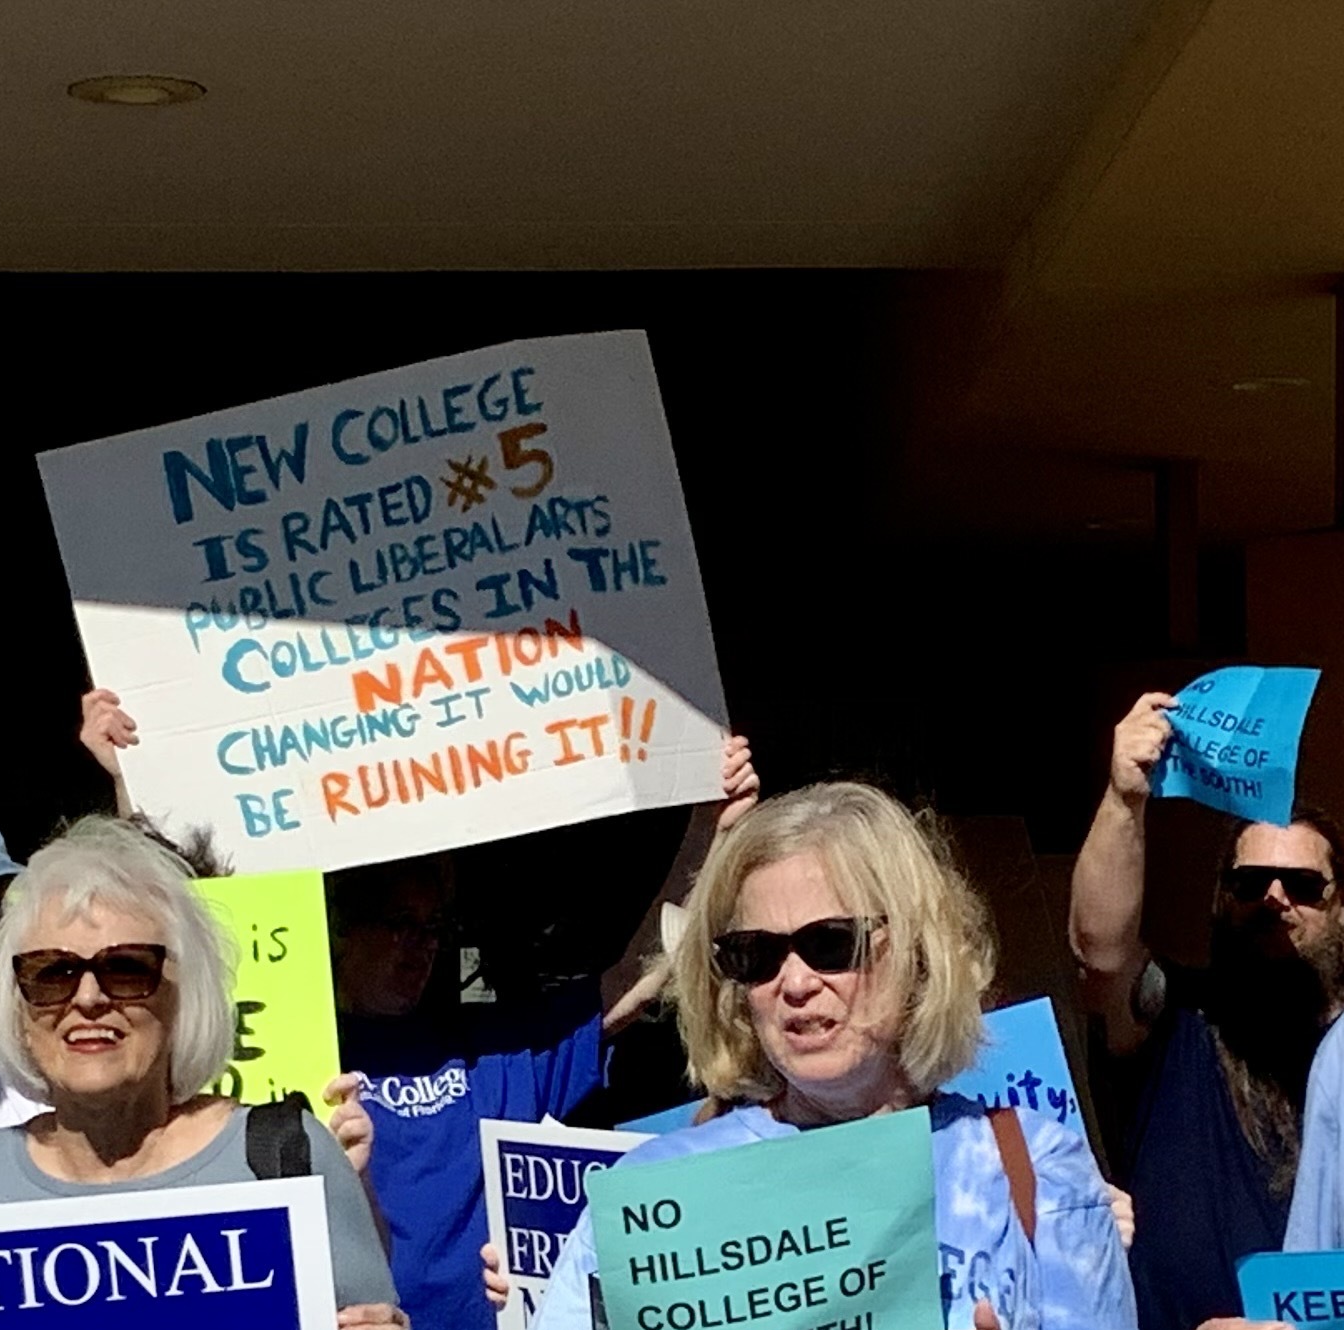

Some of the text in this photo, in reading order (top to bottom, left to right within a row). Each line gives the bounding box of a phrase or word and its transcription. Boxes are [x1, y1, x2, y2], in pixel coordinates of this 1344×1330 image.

[163, 366, 544, 524] NEW COLLEGE
[185, 496, 611, 653] PUBLIC LIBERAL ARTS
[193, 528, 267, 583] IS
[282, 477, 432, 561] RATED
[222, 541, 666, 694] COLLEGES IN THE
[352, 608, 582, 711] NATION
[217, 655, 631, 775] CHANGING IT WOULD
[237, 697, 656, 838] BE RUINING IT!!
[1244, 748, 1270, 769] OF
[622, 1199, 682, 1236] NO
[630, 1217, 850, 1284] HILLSDALE
[839, 1260, 887, 1298] OF
